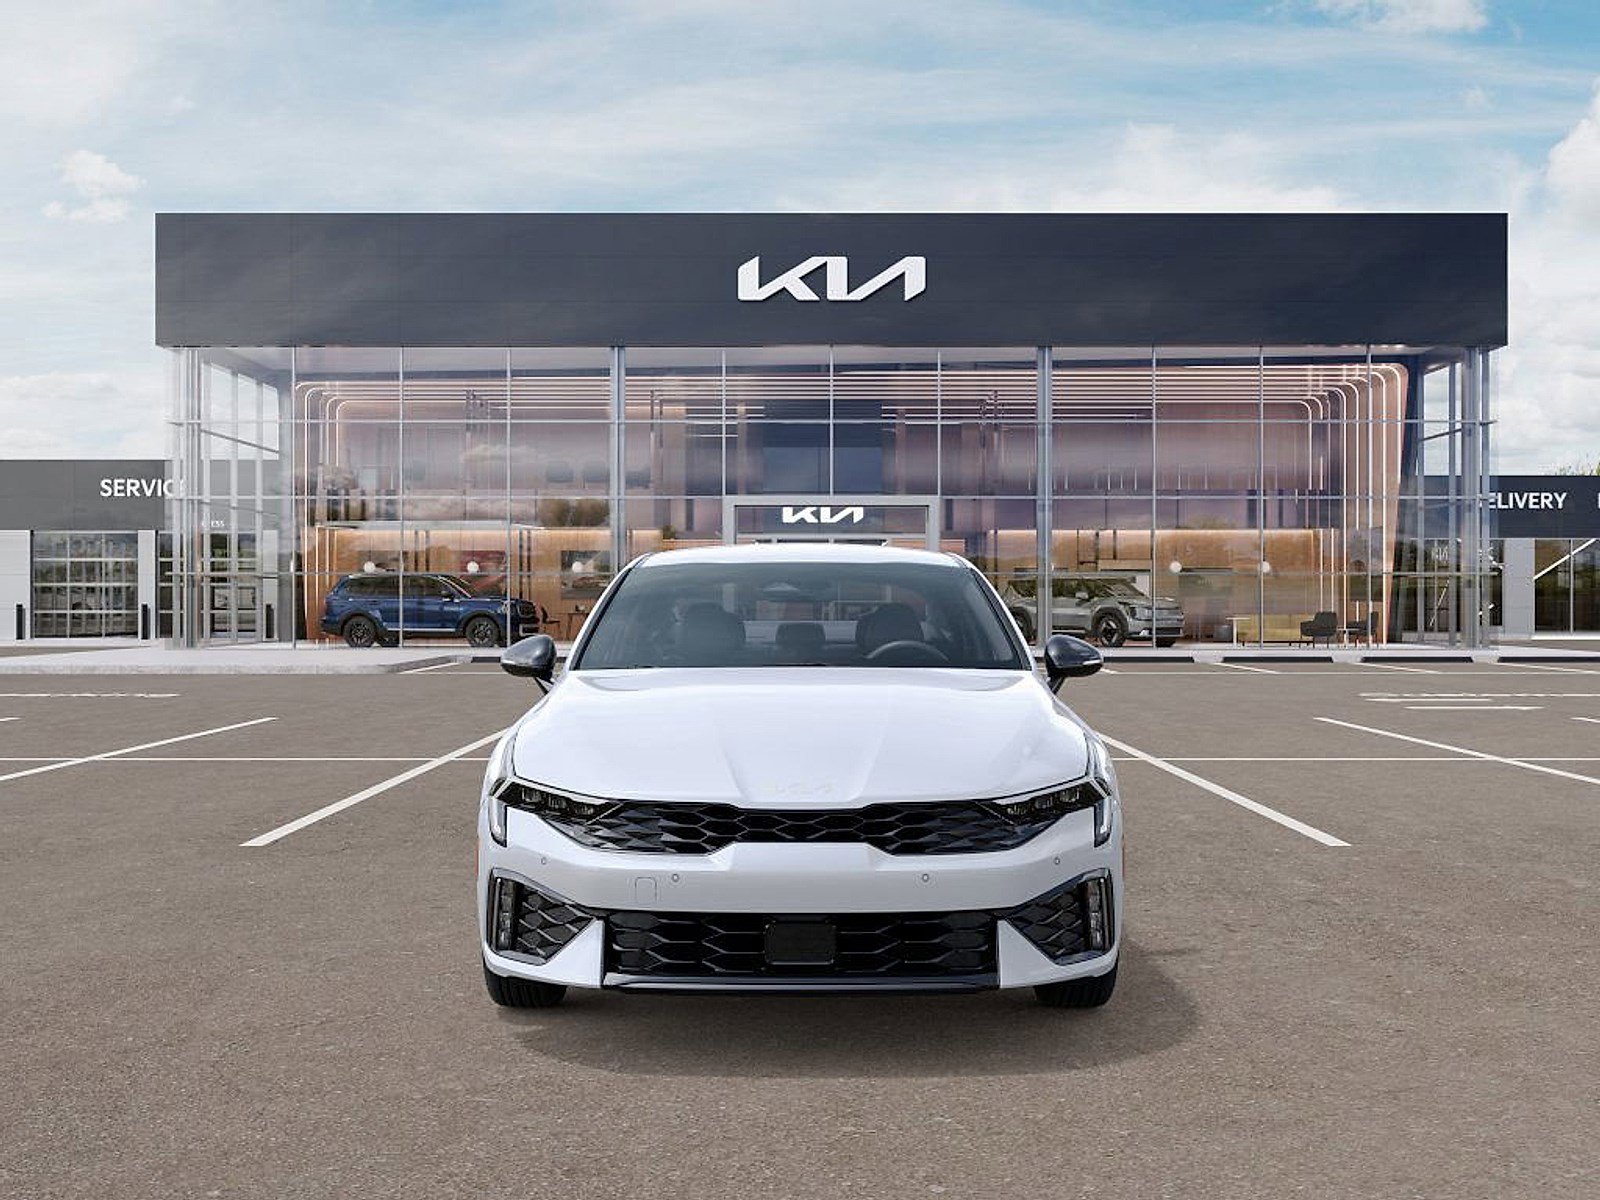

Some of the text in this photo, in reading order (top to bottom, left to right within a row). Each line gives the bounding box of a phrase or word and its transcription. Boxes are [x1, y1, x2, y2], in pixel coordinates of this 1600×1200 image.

[738, 256, 926, 301] KIA
[1477, 492, 1567, 509] ELIVERY
[782, 506, 864, 523] KIA
